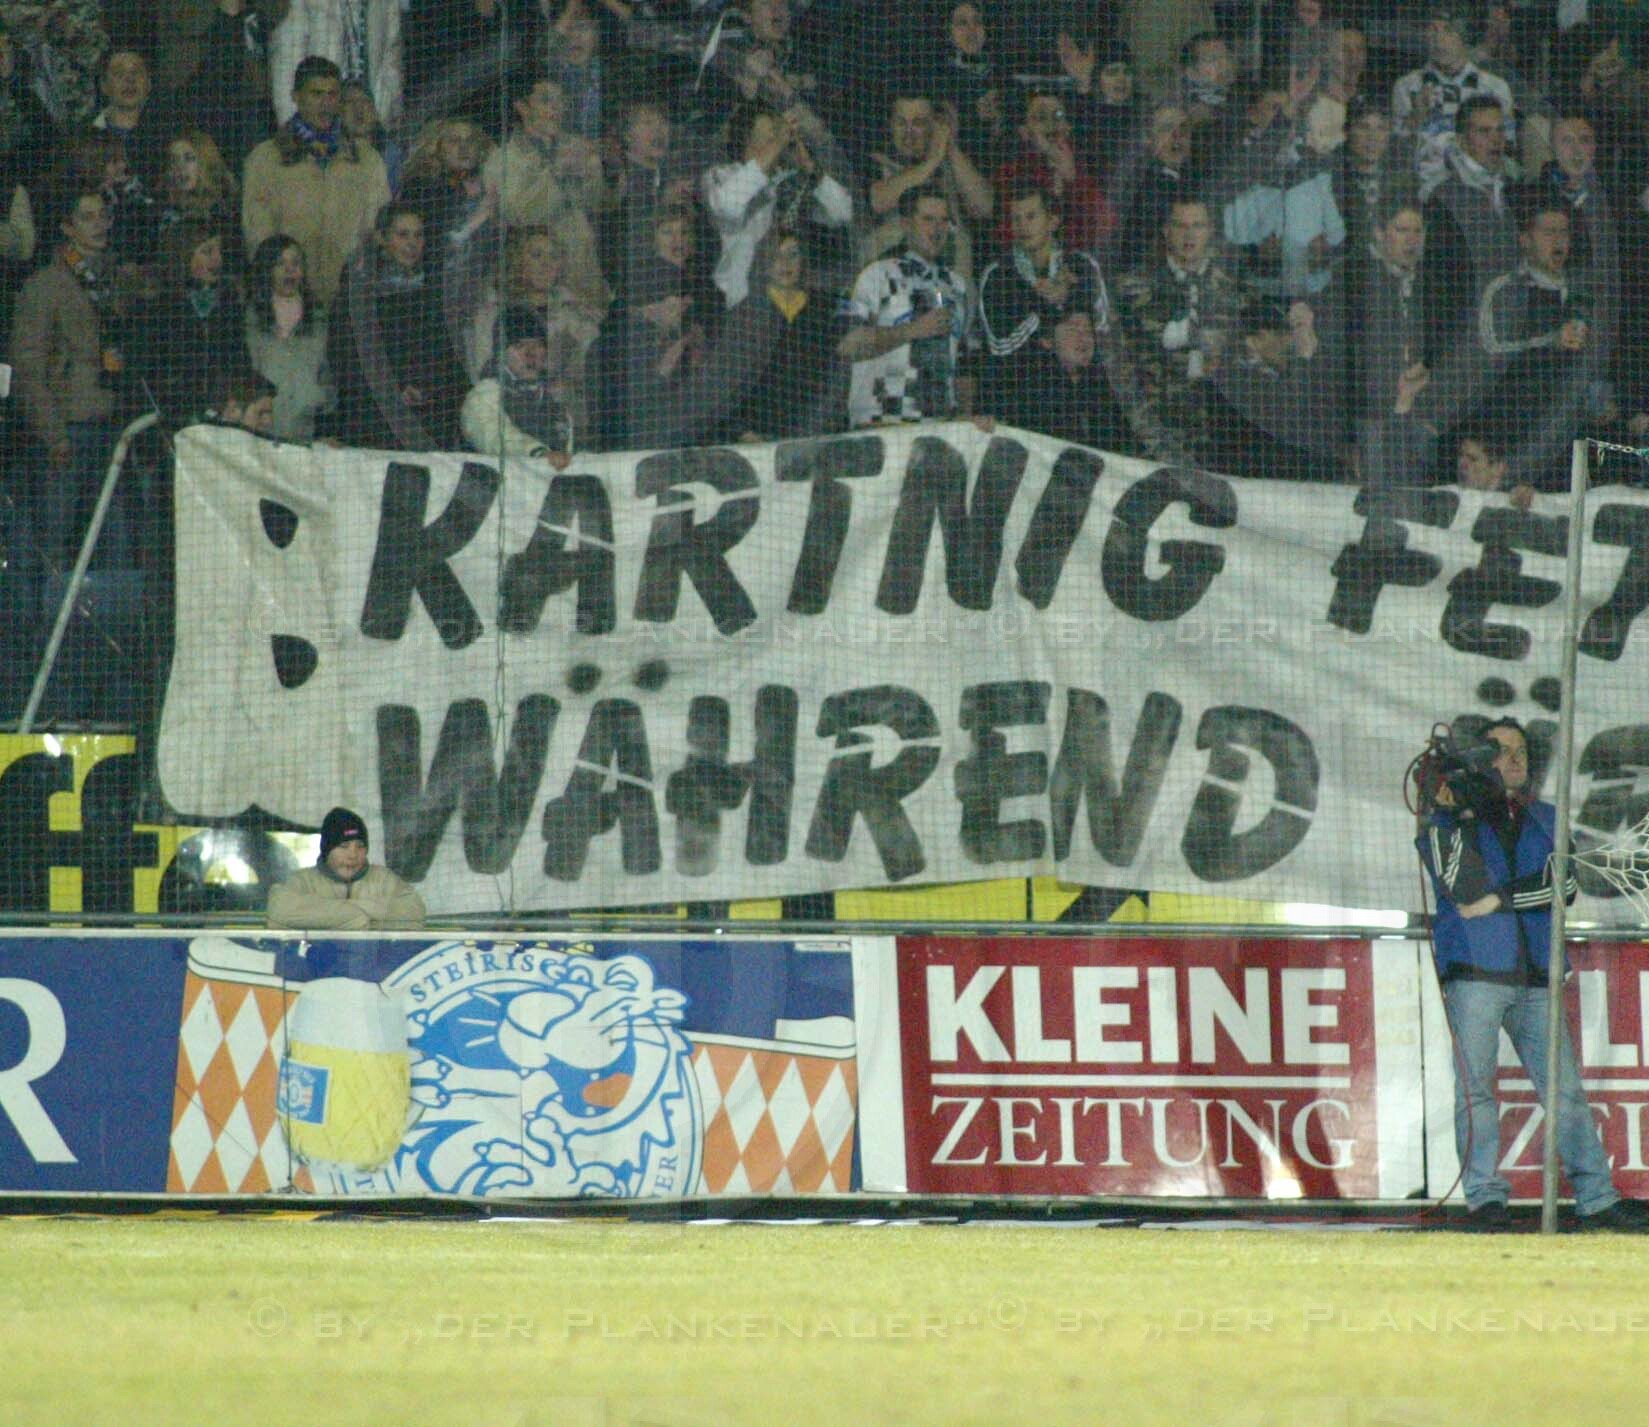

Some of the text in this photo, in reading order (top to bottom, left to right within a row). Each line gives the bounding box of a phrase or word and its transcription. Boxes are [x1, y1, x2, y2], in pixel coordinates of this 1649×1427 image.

[360, 434, 1238, 650] KARTNIG
[376, 660, 1320, 884] WÄHREND
[926, 964, 1351, 1066] KLEINE
[929, 1096, 1357, 1170] ZEITUNG
